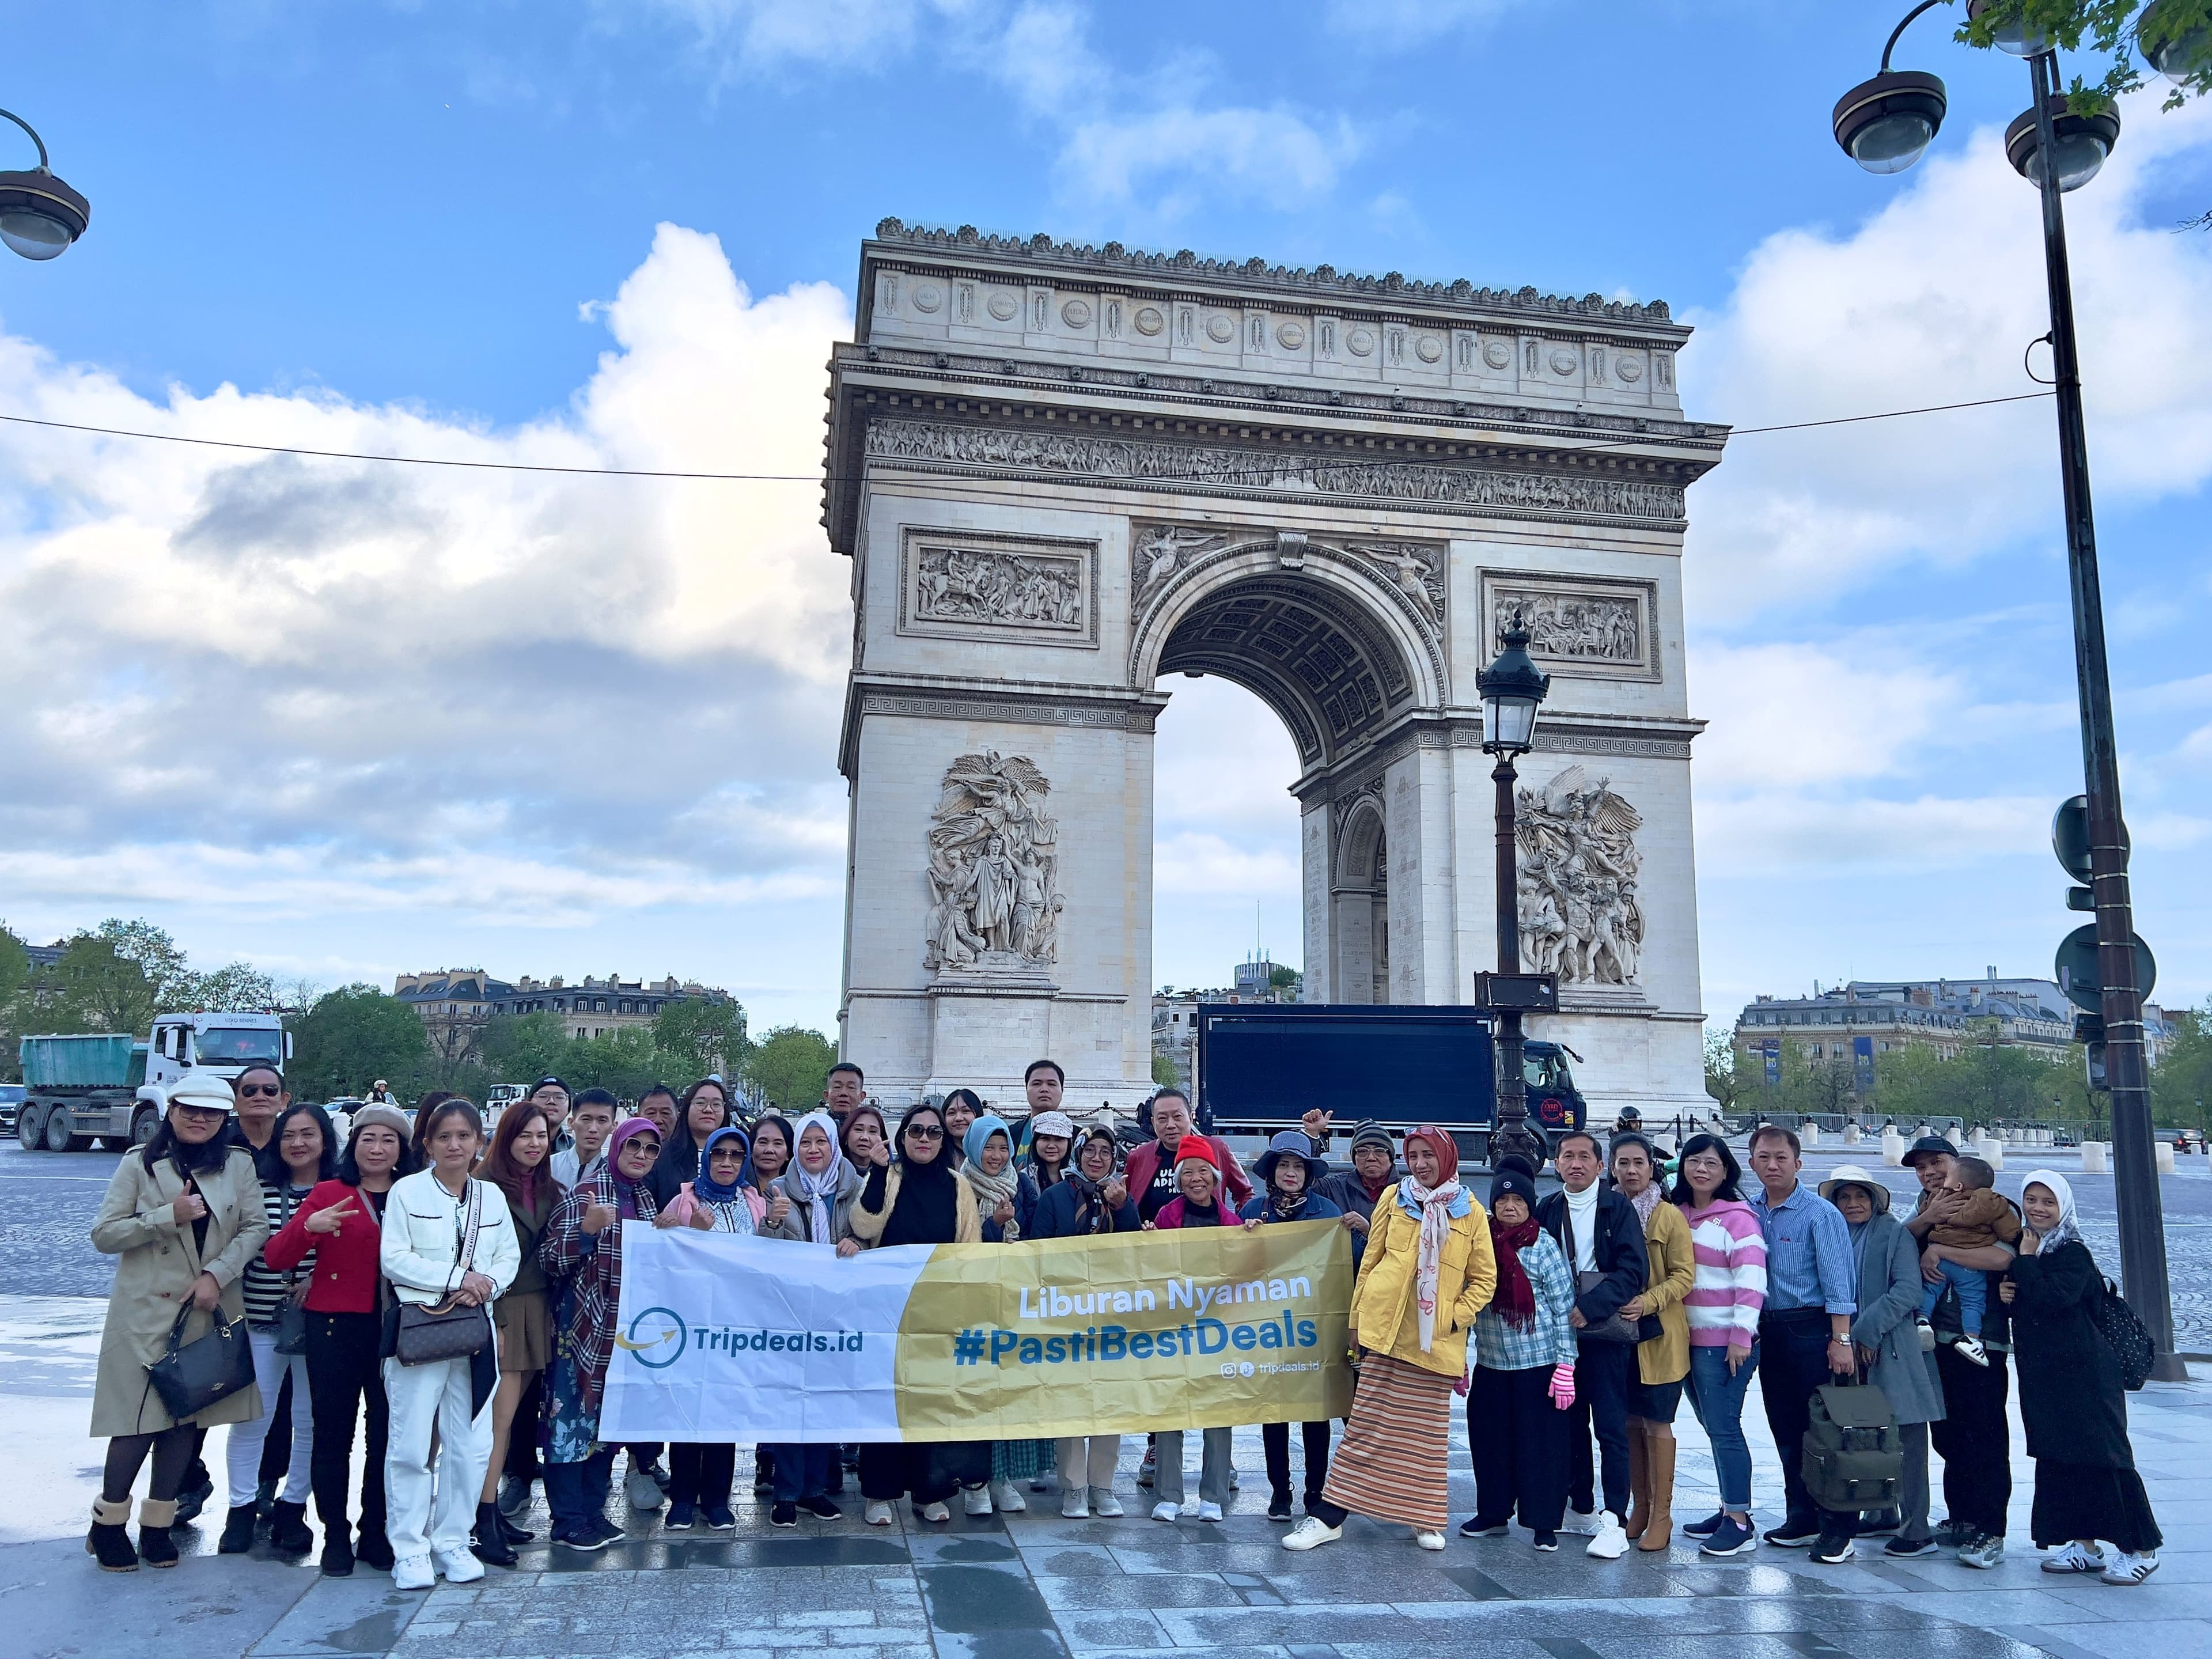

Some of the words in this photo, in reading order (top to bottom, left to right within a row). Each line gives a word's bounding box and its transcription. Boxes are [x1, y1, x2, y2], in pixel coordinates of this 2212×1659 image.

[1215, 323, 1229, 331] LODI
[1160, 1168, 1175, 1177] UL
[1154, 1177, 1172, 1187] ADI
[1018, 1286, 1156, 1319] Liburan
[1166, 1275, 1311, 1317] Nyaman
[694, 1327, 863, 1358] Tripdeals.id
[953, 1309, 1317, 1365] #PastiBestDeals
[1259, 1360, 1320, 1375] tripdeals.id
